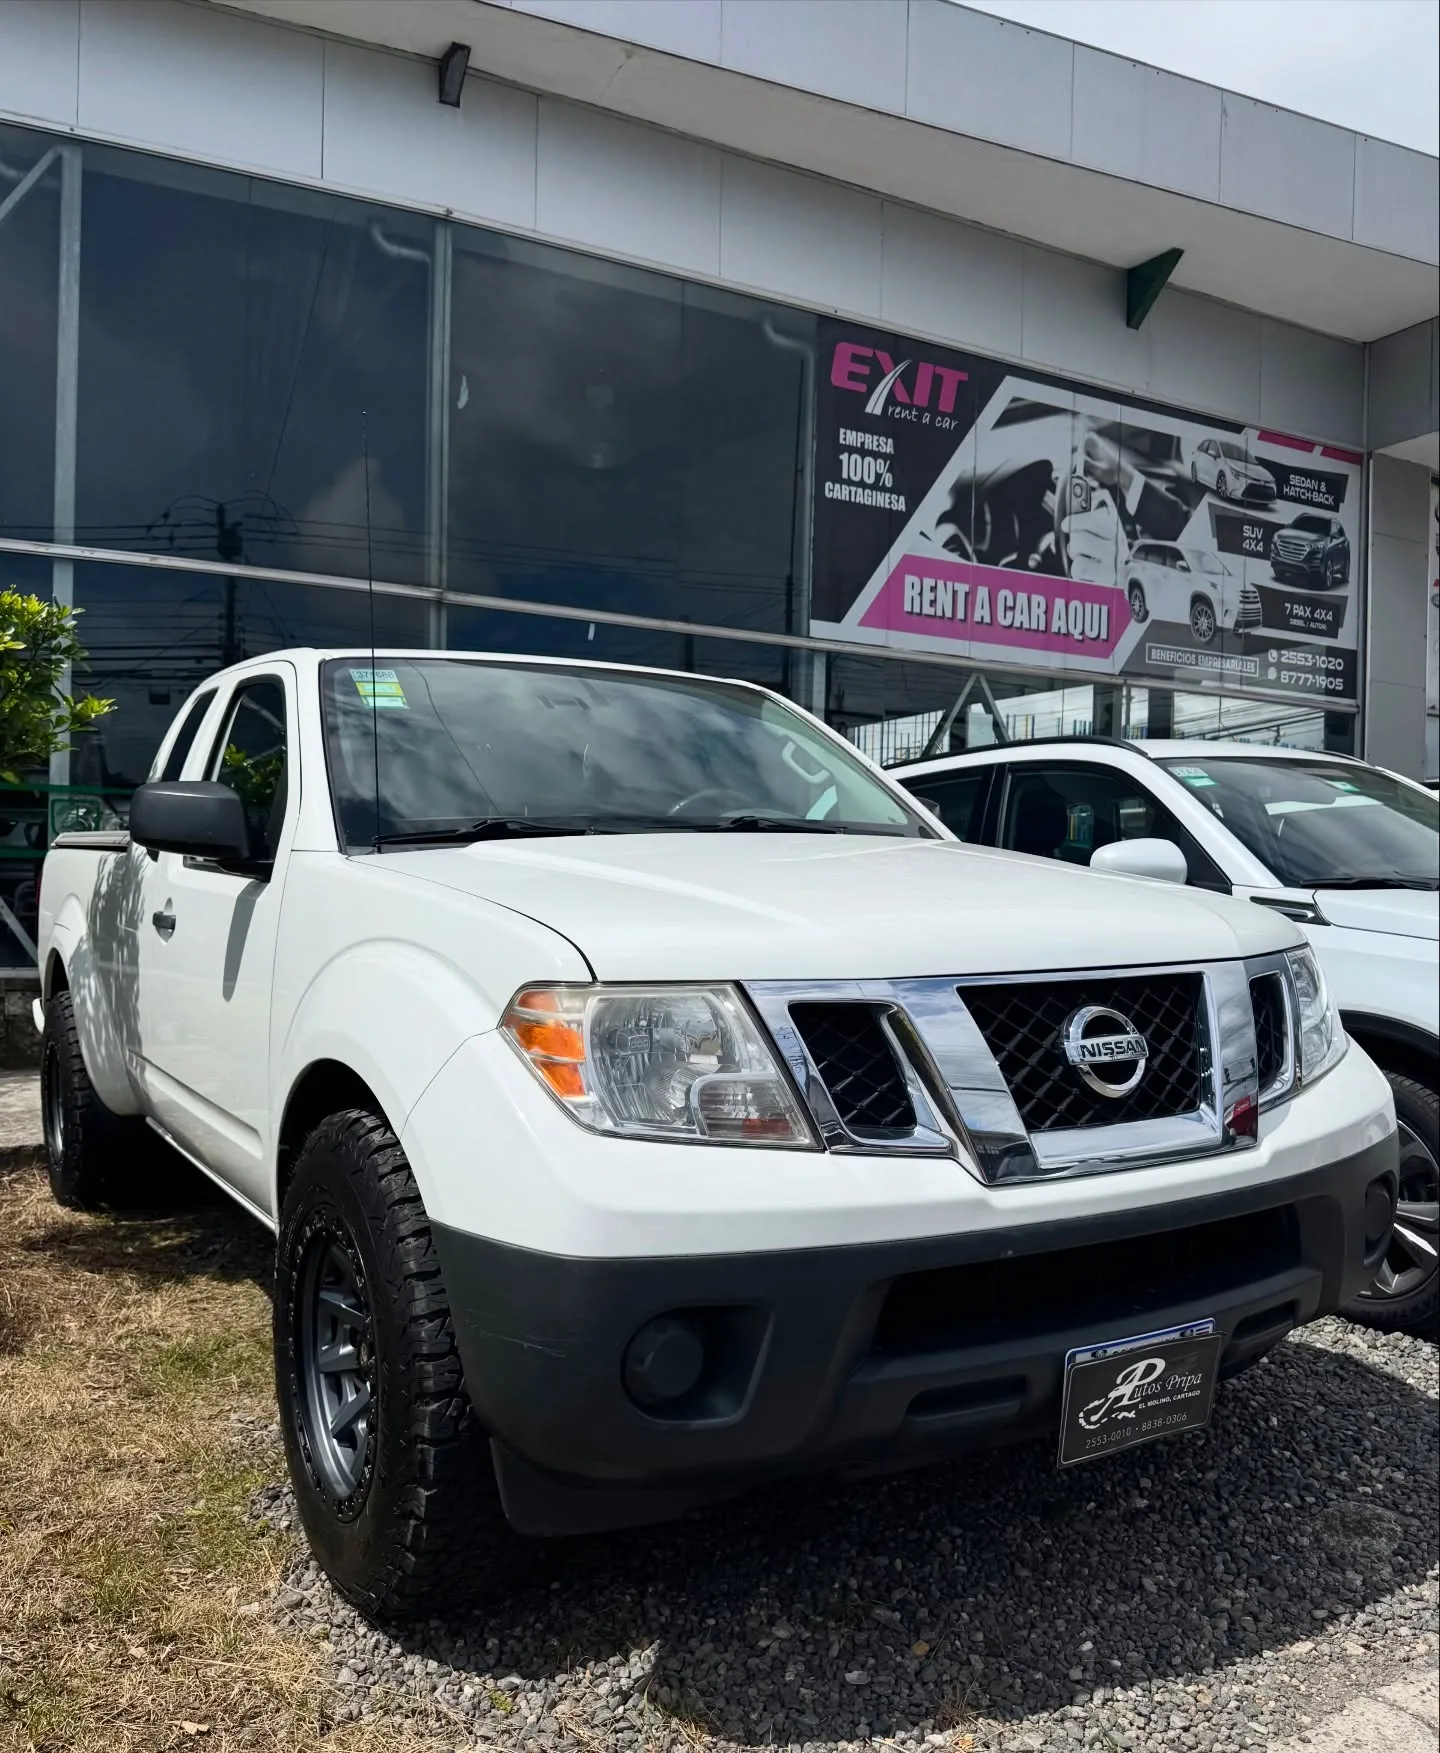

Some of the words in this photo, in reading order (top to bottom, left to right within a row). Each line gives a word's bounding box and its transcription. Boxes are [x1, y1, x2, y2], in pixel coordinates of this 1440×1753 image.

[830, 342, 969, 416] EXIT
[887, 403, 919, 422] rent
[922, 412, 931, 425] a
[935, 417, 959, 431] car
[839, 427, 894, 454] EMPRESA
[839, 452, 893, 488] 100%
[1289, 474, 1319, 491] SEDAN
[1320, 481, 1327, 492] &
[824, 481, 906, 512] CARTAGINESA
[1242, 525, 1264, 539] SUV
[1242, 537, 1264, 553] 4X4
[903, 573, 970, 621] RENT
[973, 585, 992, 625] A
[997, 588, 1047, 633] CAR
[1051, 597, 1110, 642] AQUI
[1284, 602, 1291, 615] 7
[1292, 603, 1312, 618] PAX
[1313, 608, 1333, 622] 4X4
[1151, 648, 1196, 665] BENEFICIOS
[1079, 1039, 1147, 1058] NISSAN
[1165, 1371, 1202, 1391] Pripa
[1172, 1390, 1201, 1402] CARTAGO
[1085, 1426, 1132, 1449] 2553-0010
[1141, 1412, 1188, 1432] 8838-0306
